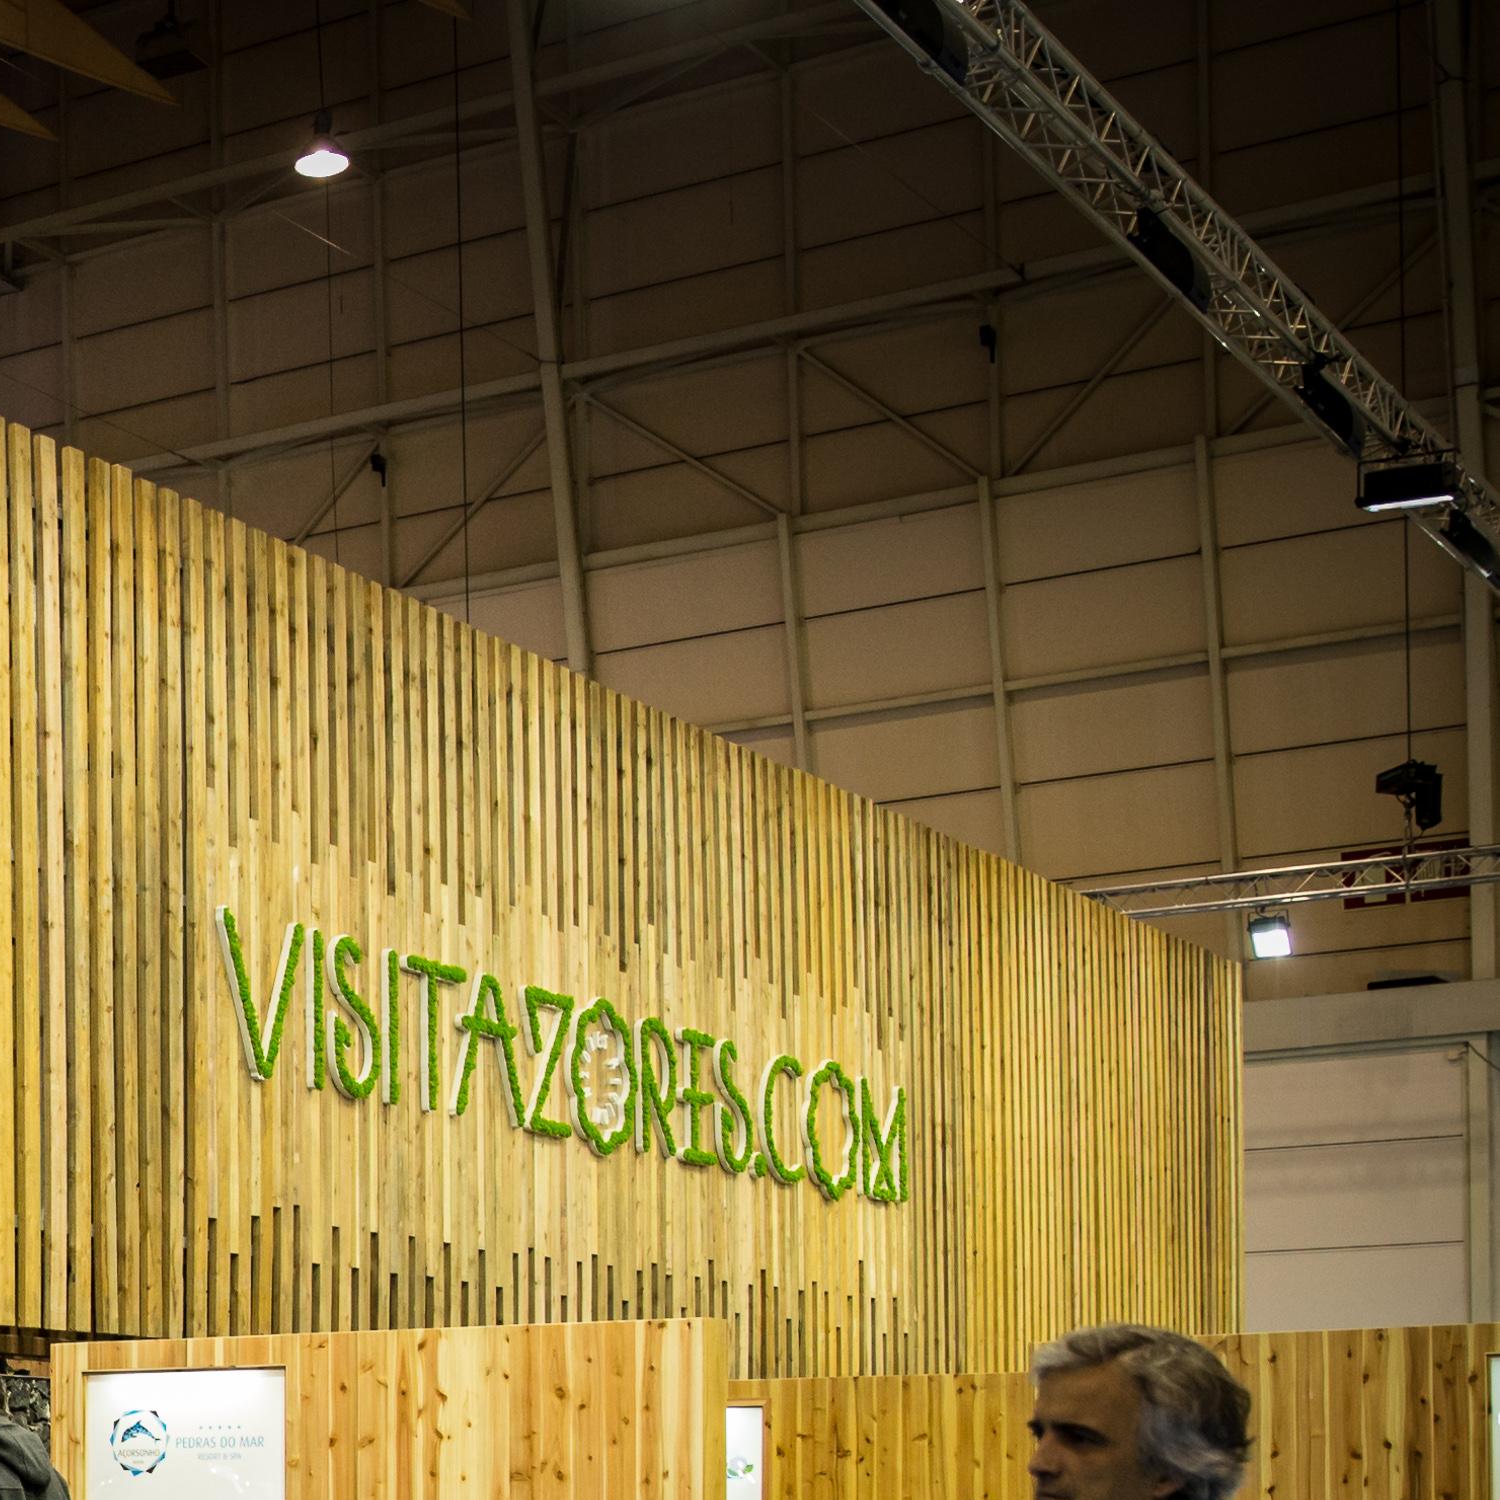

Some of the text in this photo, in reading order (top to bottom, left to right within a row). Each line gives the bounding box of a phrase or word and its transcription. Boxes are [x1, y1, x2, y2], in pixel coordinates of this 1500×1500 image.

[214, 904, 910, 1204] VISITAZORES.COM
[175, 1435, 265, 1448] PEDRAS DO MAR
